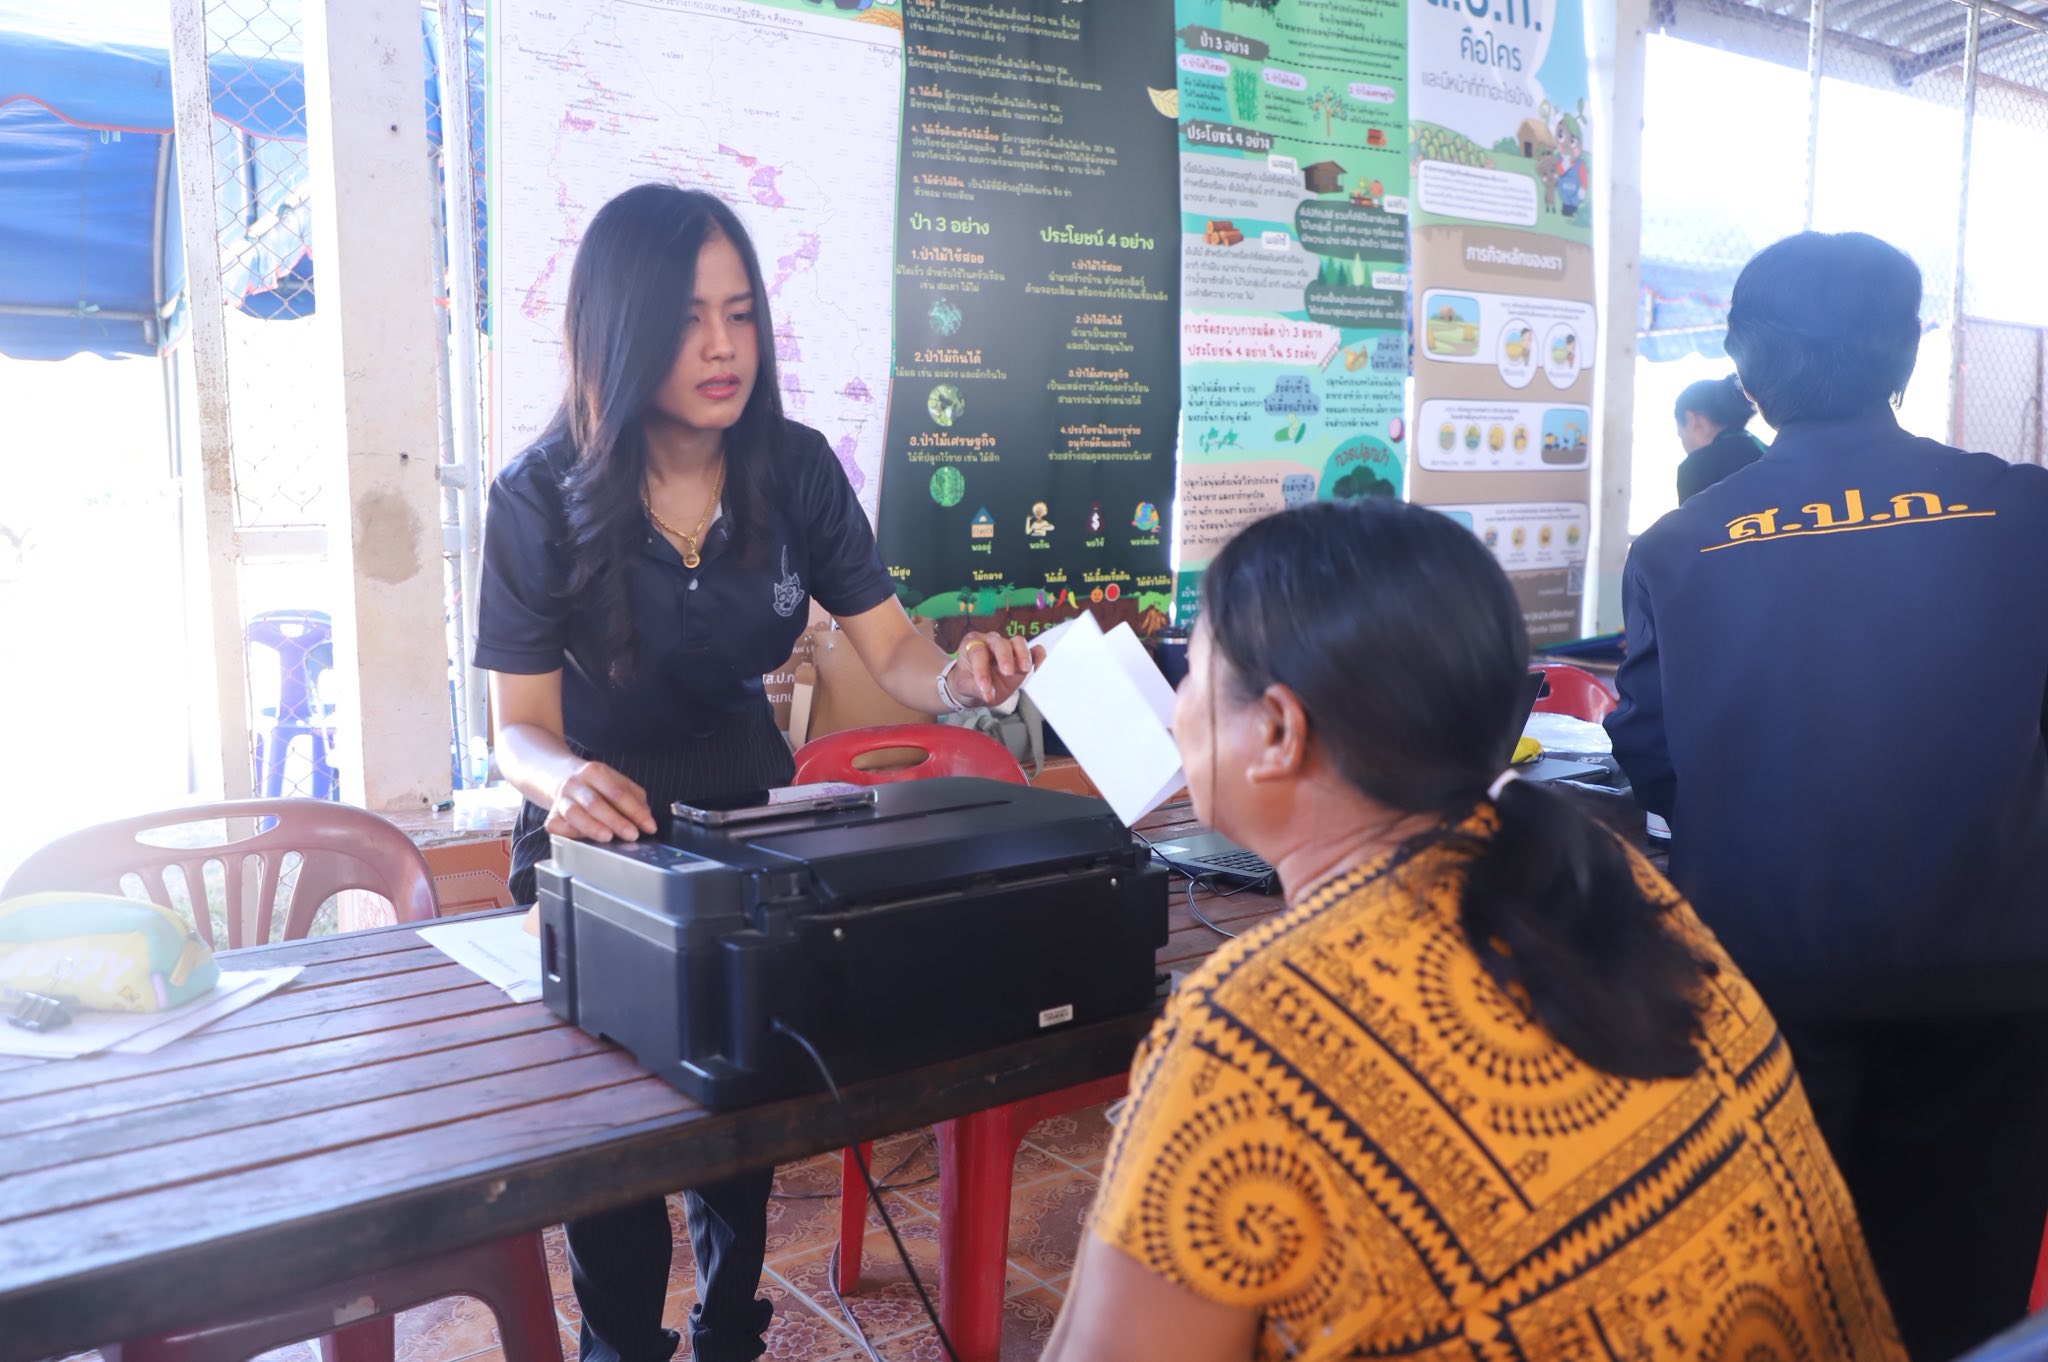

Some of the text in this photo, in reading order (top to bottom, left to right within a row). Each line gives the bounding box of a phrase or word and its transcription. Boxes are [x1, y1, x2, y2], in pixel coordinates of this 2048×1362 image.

[1200, 30, 1249, 55] ป่า 3 อย่าง
[1460, 26, 1522, 72] คือใคร
[1421, 70, 1534, 107] และมีหน้าที่ทำอะไรบ้าง
[1187, 124, 1234, 145] ประโยชน์
[1246, 132, 1270, 149] อย่าง
[910, 212, 990, 236] ป่า 3 อย่าง
[1040, 224, 1154, 250] ประโยชน์ 4 อย่าง
[911, 245, 984, 265] 1.ป่าไม้ใช้สอย
[914, 348, 982, 365] 2.ป่าไม้กินได้
[909, 432, 996, 451] 3.ป่าไม้เศรษฐกิจ
[1724, 489, 1969, 540] ส.ป.ก.
[888, 566, 911, 581] ไม้สูง
[973, 570, 1003, 581] ไม้กลาง
[1006, 620, 1026, 637] ป่า
[1030, 621, 1041, 636] 5
